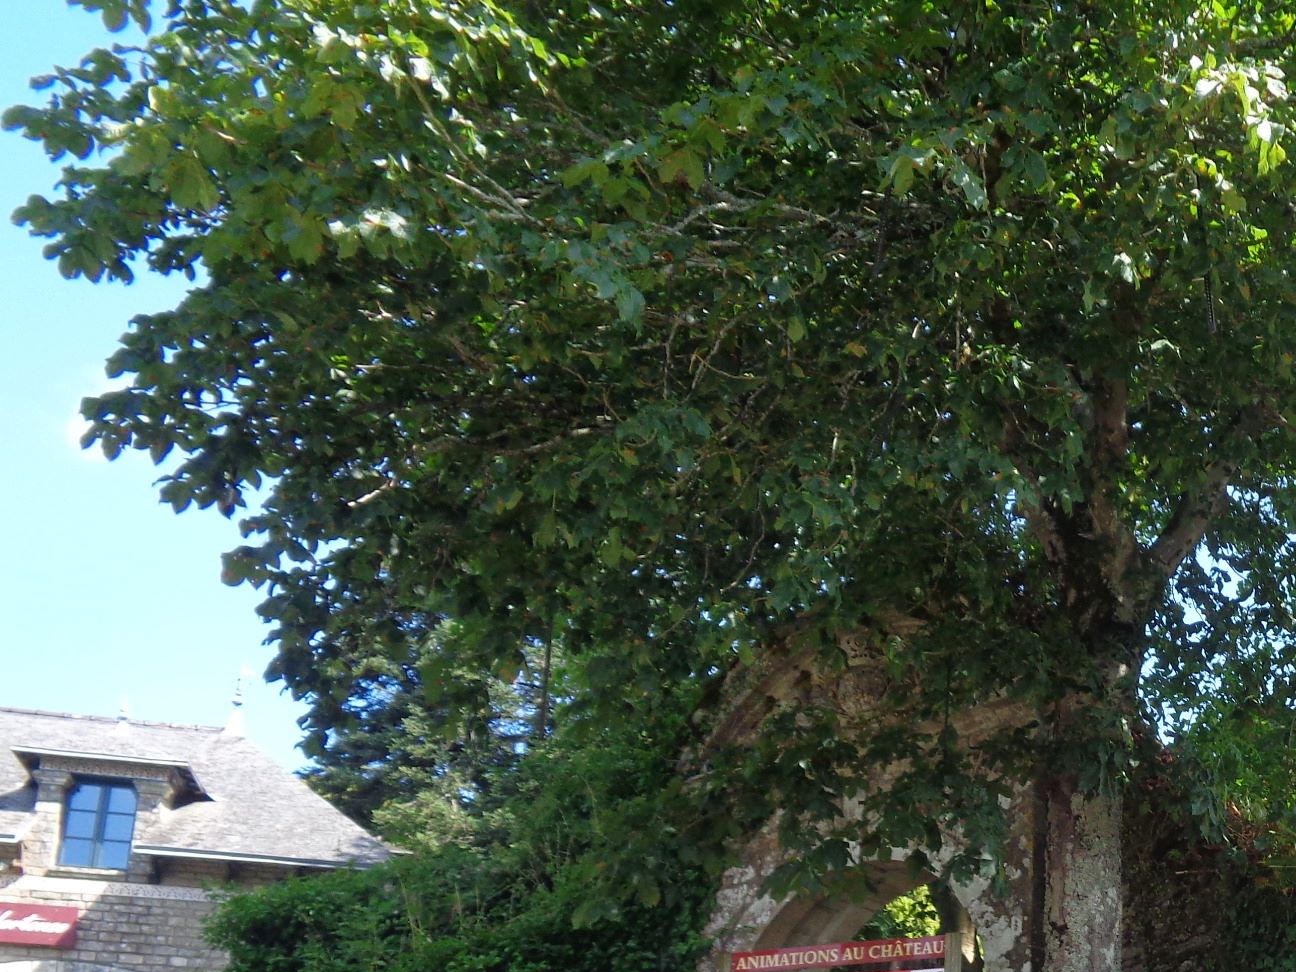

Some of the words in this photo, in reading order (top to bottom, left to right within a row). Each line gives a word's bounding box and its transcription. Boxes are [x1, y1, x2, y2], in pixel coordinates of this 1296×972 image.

[736, 948, 839, 970] ANIMATIONS
[842, 946, 865, 961] AU
[869, 940, 944, 958] CHÂTEAU
